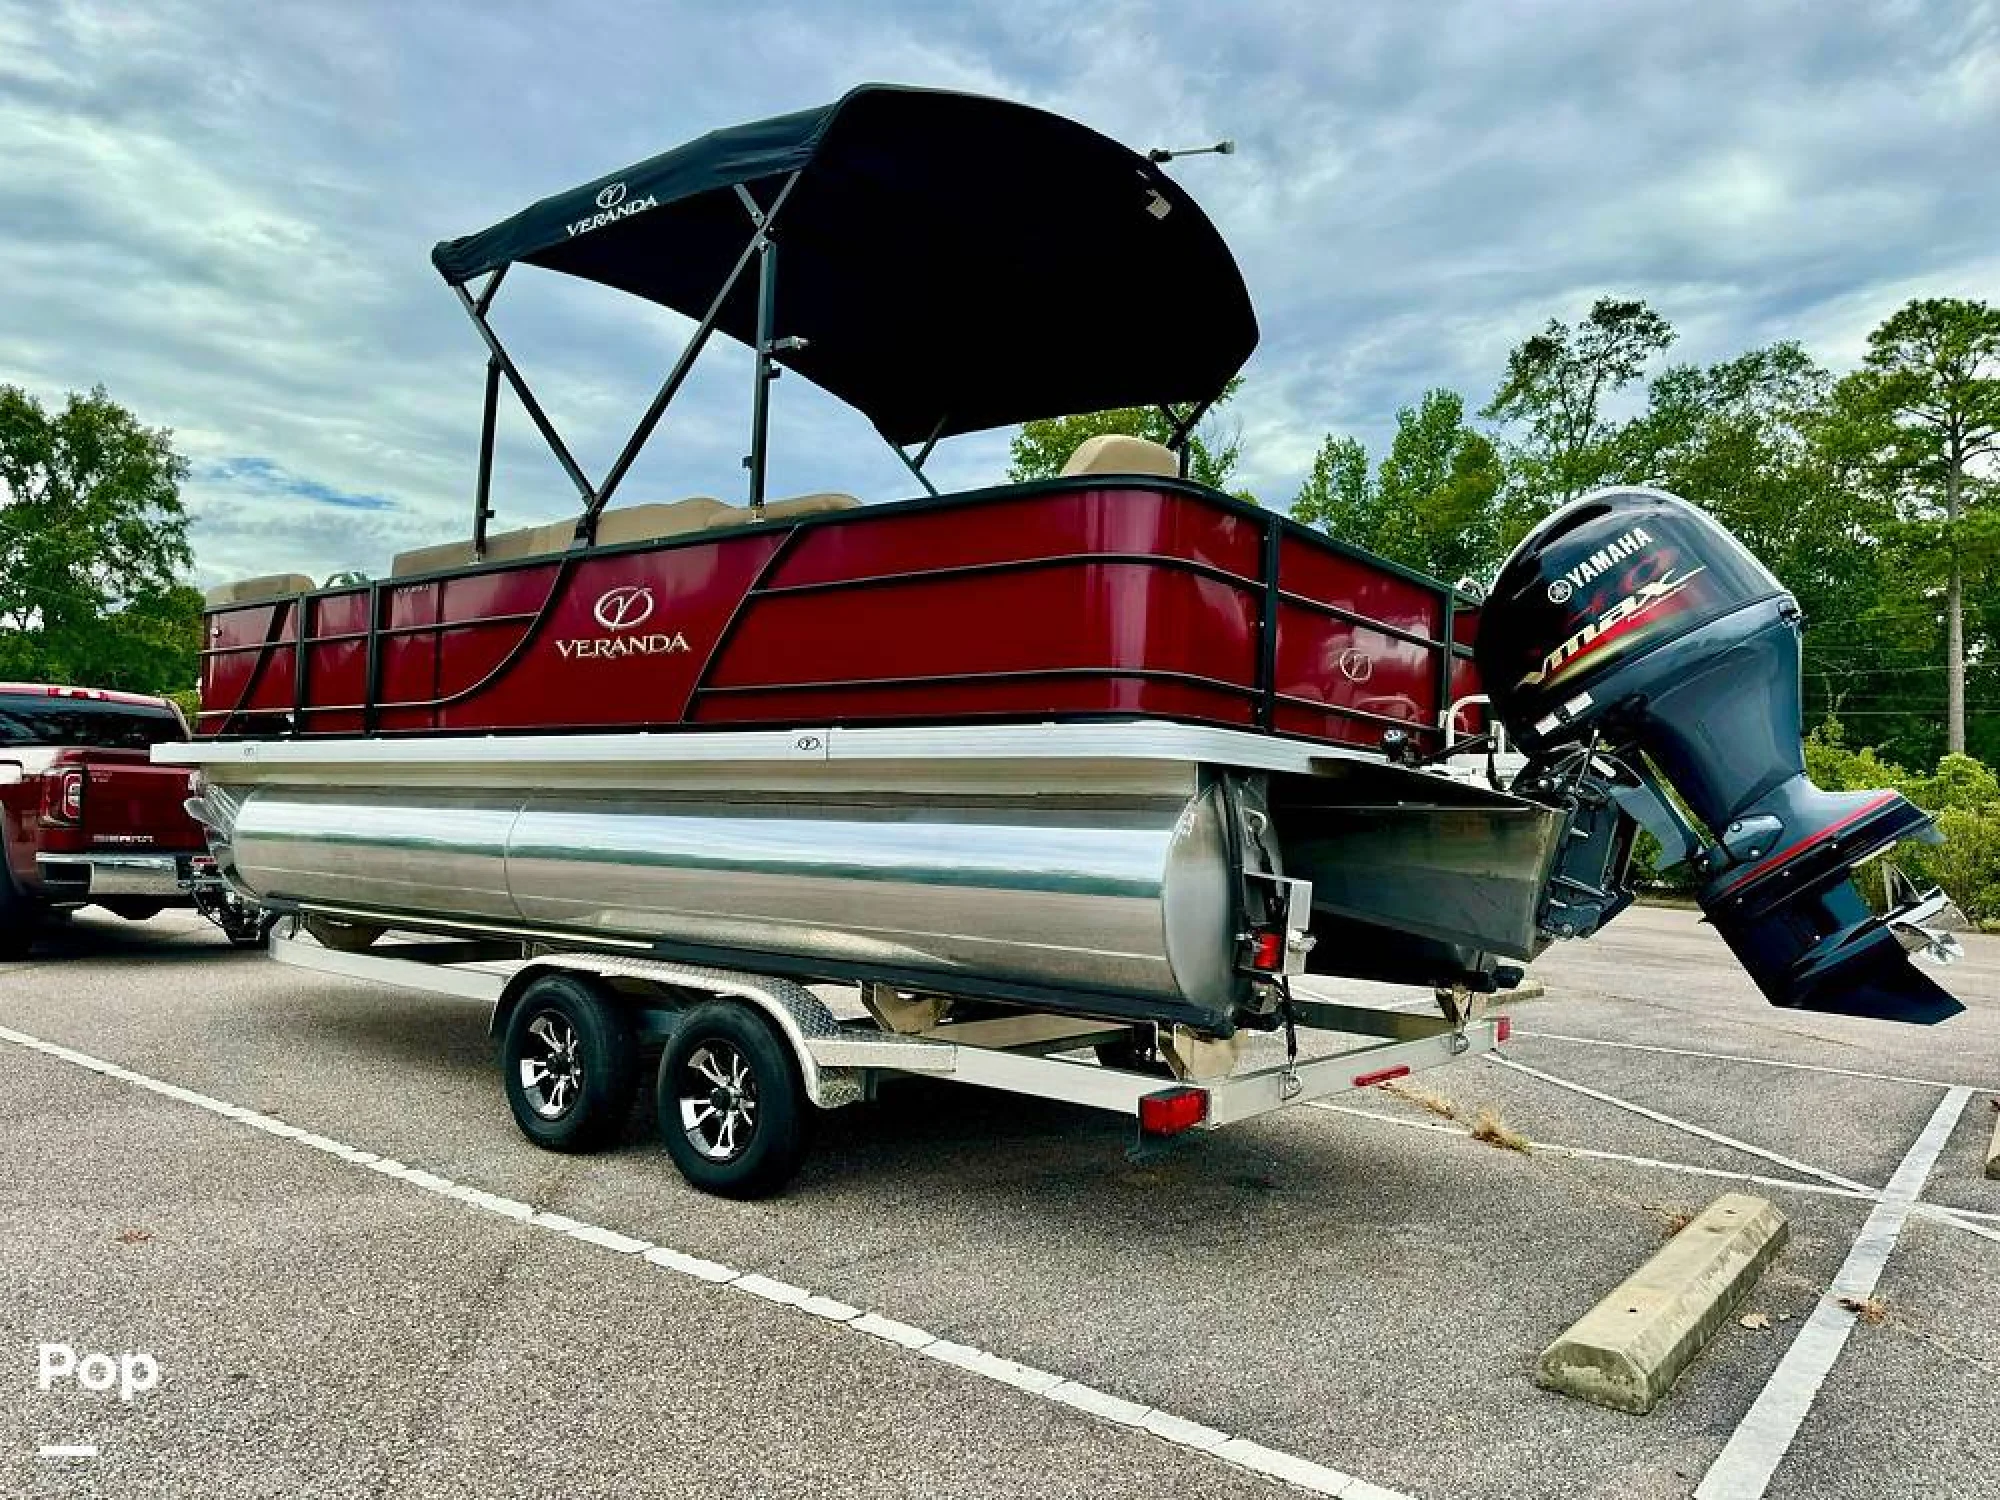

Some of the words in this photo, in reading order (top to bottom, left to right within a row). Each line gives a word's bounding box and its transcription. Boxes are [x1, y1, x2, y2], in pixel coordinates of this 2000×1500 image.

[565, 194, 657, 235] VERANDA
[1565, 527, 1653, 589] YAMAHA
[555, 632, 692, 659] VERANDA
